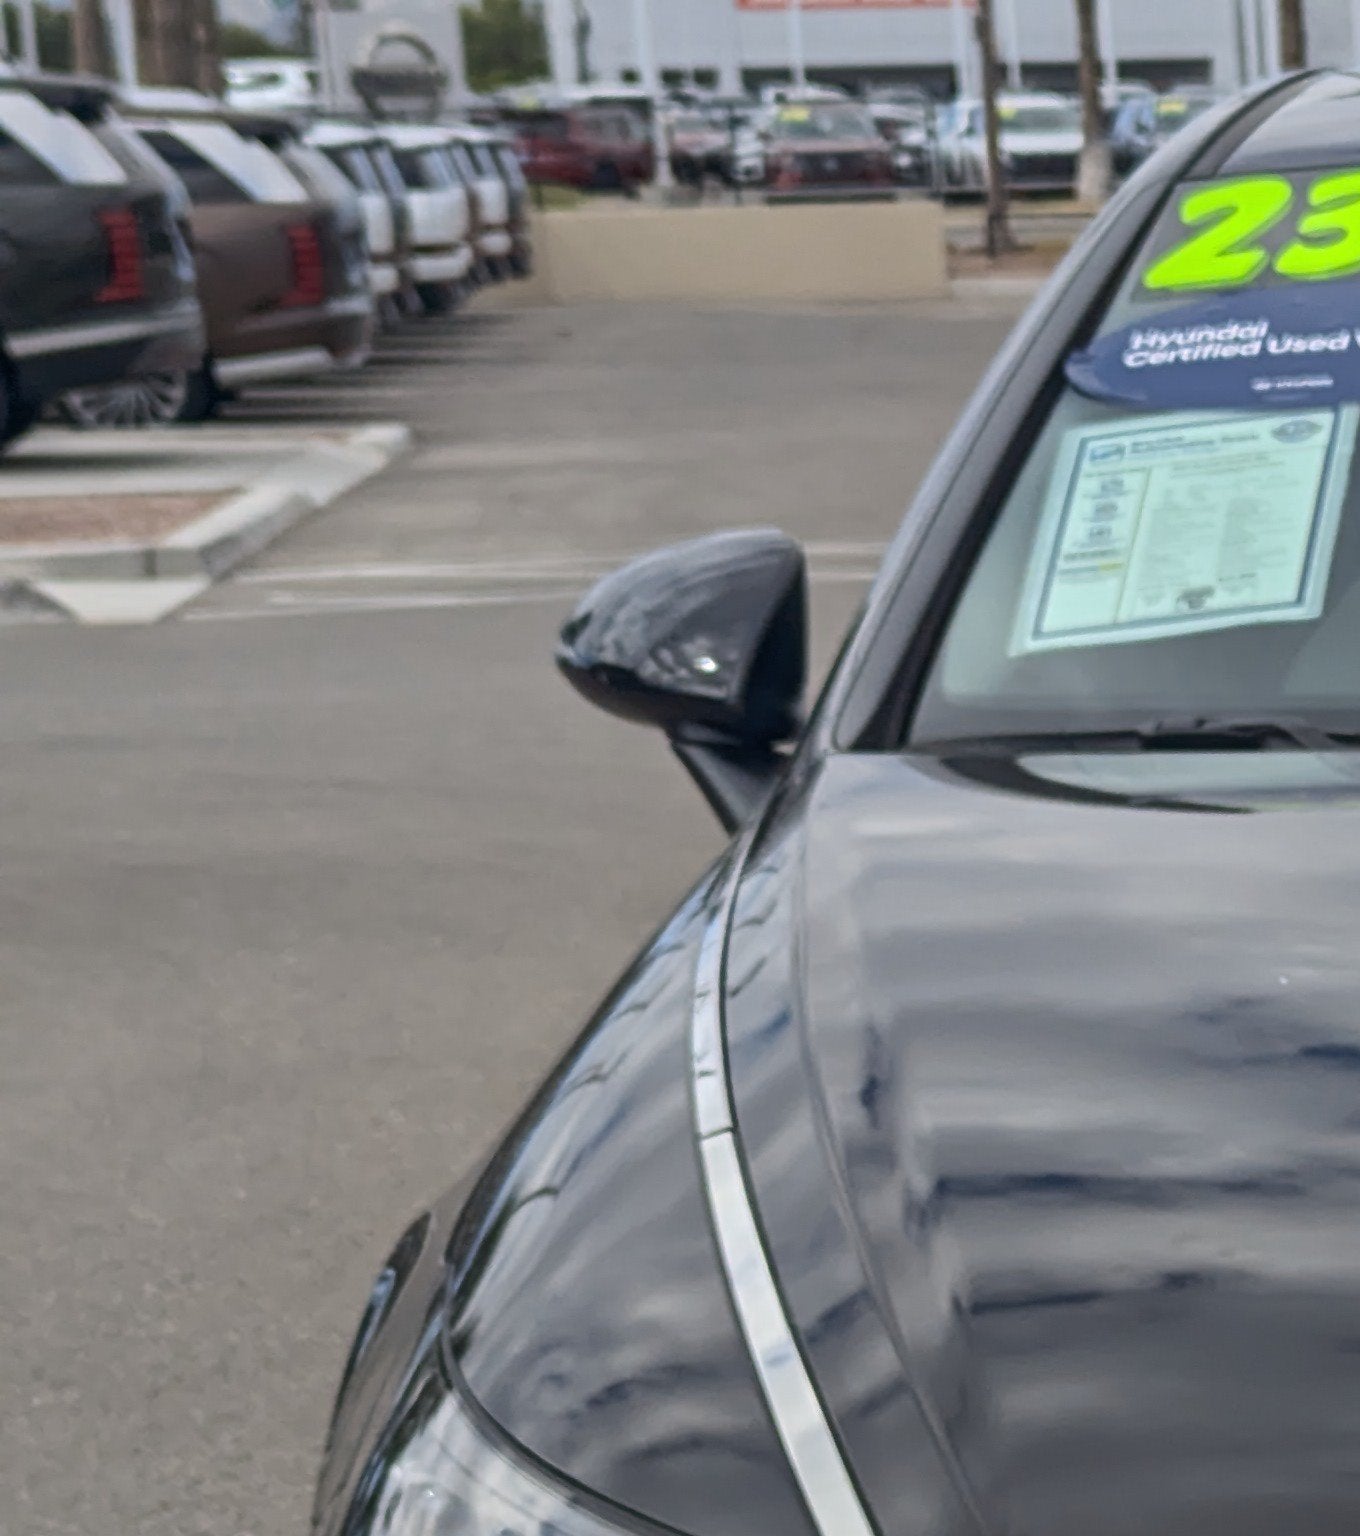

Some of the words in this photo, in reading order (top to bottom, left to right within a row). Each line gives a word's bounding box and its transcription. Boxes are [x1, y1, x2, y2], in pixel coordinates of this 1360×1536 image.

[1123, 339, 1262, 368] Certified
[1268, 330, 1350, 354] Used
[1128, 320, 1269, 350] Hyundai
